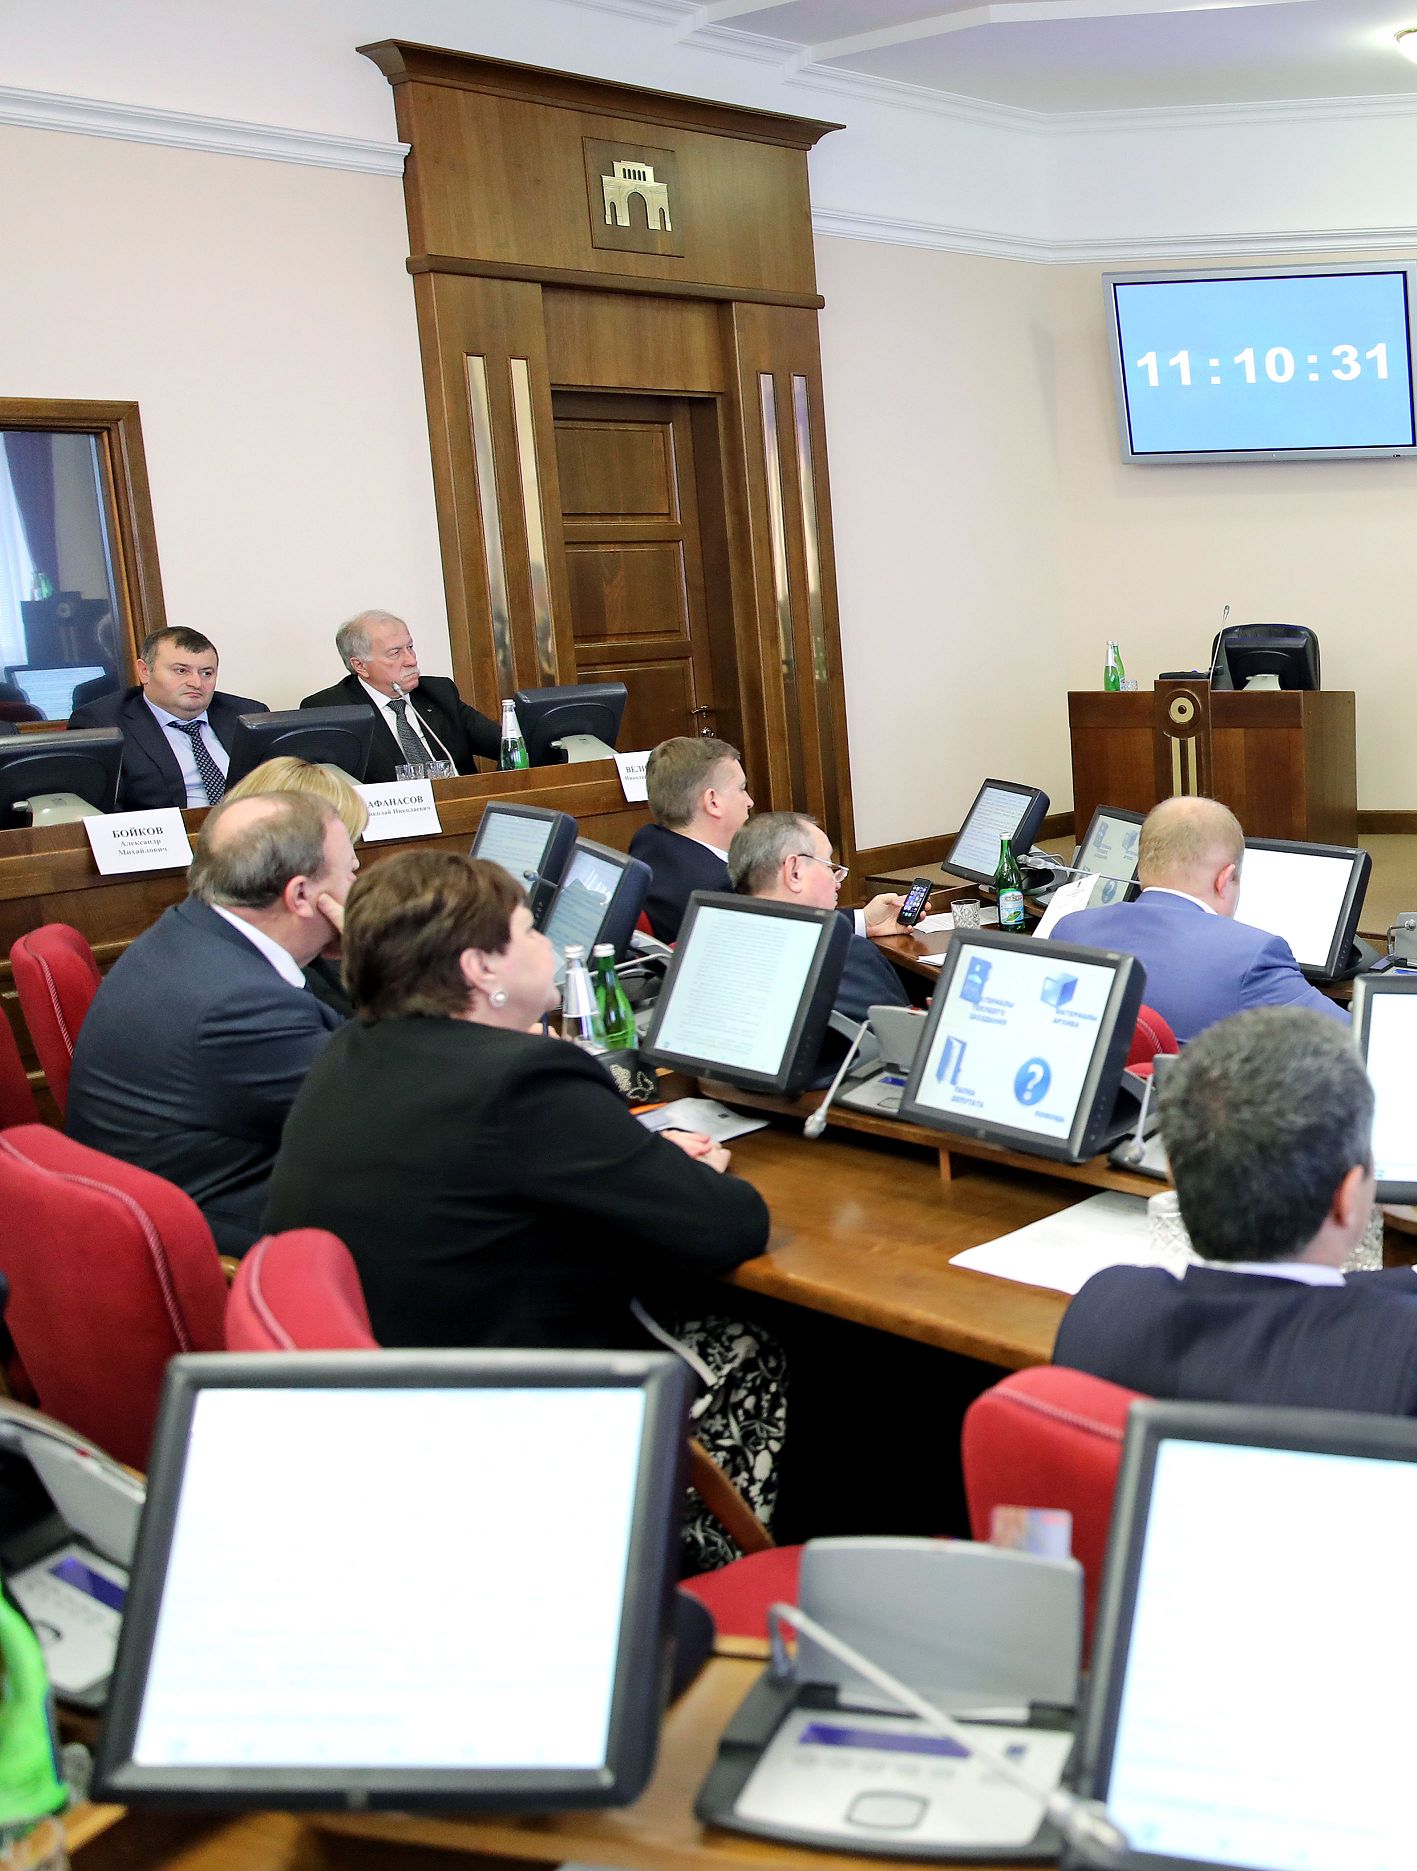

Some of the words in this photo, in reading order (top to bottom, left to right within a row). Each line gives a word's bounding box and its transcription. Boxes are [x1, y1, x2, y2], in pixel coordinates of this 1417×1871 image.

[1136, 342, 1388, 387] 11:10:31
[368, 795, 424, 808] АФАНАСОВ
[112, 826, 164, 839] БОЙКОВ
[120, 839, 161, 847] Александр
[118, 847, 168, 856] Михайлович
